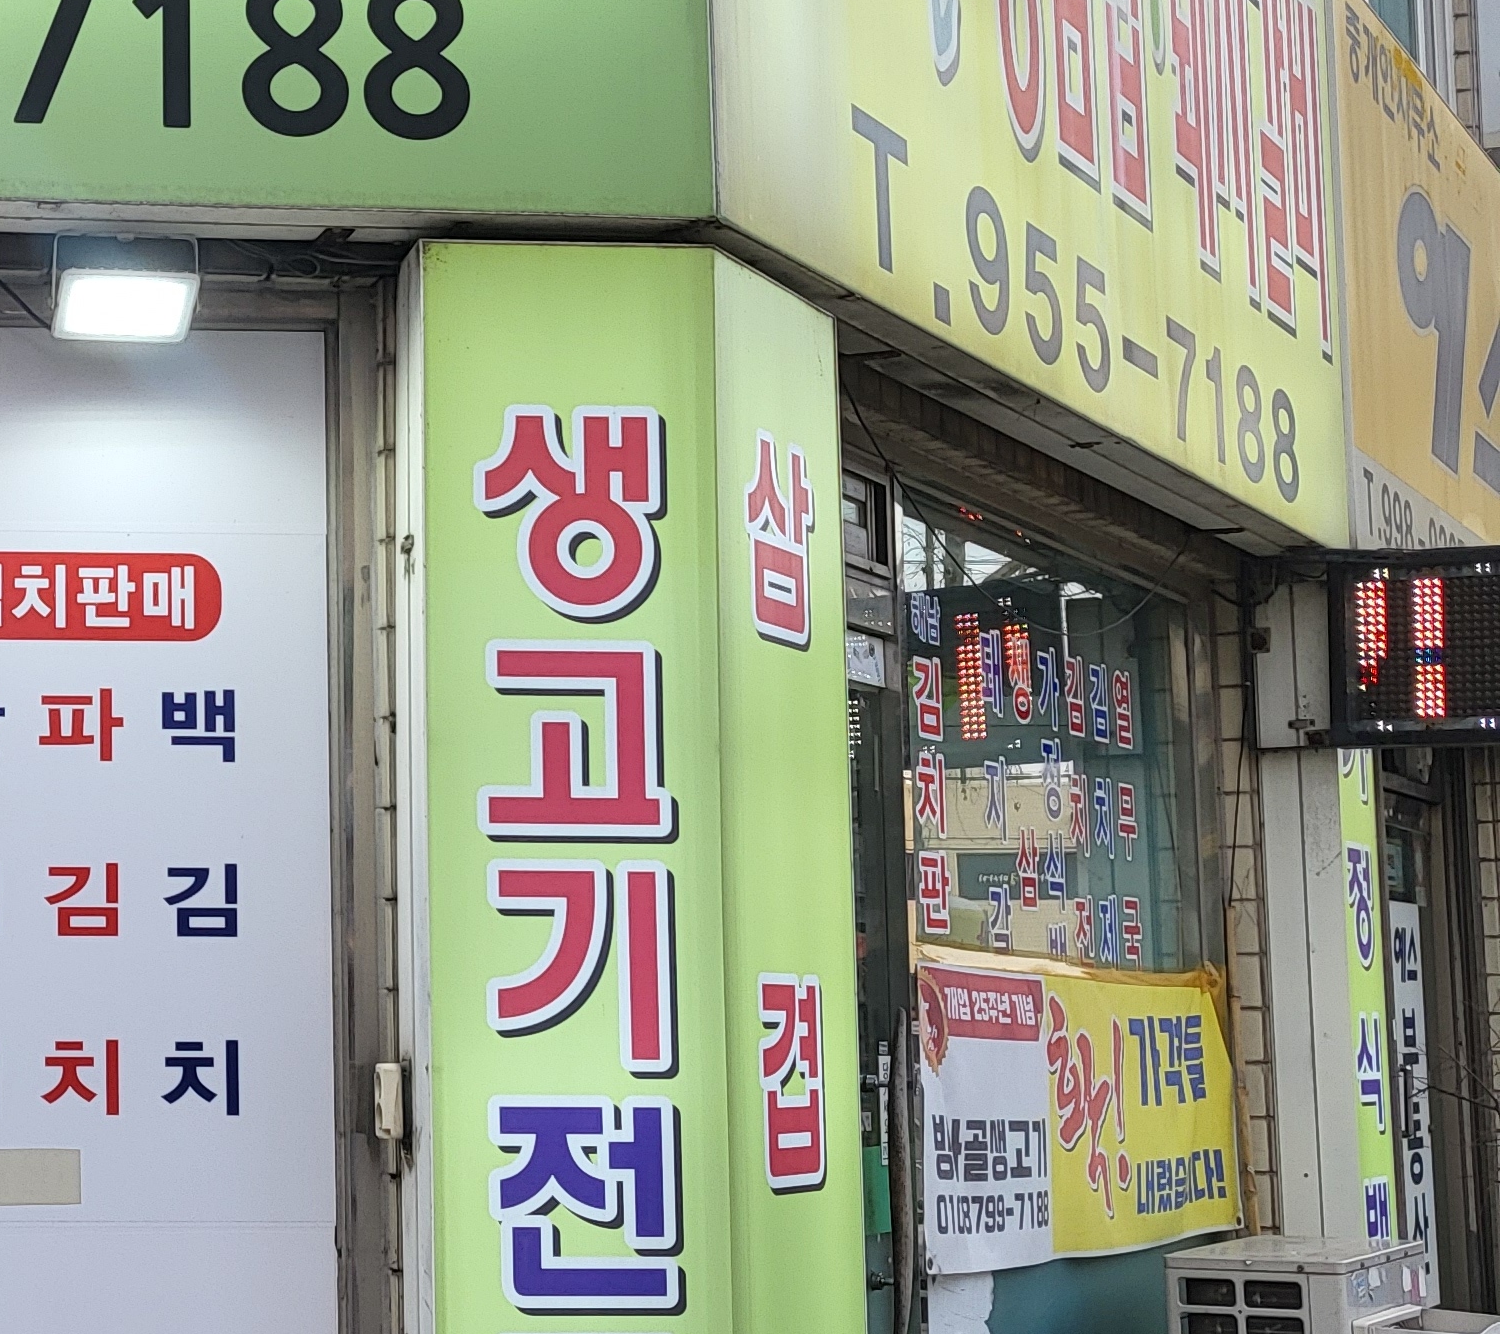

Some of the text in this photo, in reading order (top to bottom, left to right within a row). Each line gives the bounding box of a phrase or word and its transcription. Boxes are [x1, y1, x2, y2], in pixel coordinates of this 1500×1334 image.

[850, 102, 1300, 504] T.955-7188
[1362, 466, 1465, 548] T.998-
[38, 687, 124, 1117] 파김치
[160, 688, 241, 1117] 백김치
[943, 987, 1036, 1025] 개업 25주년 기념
